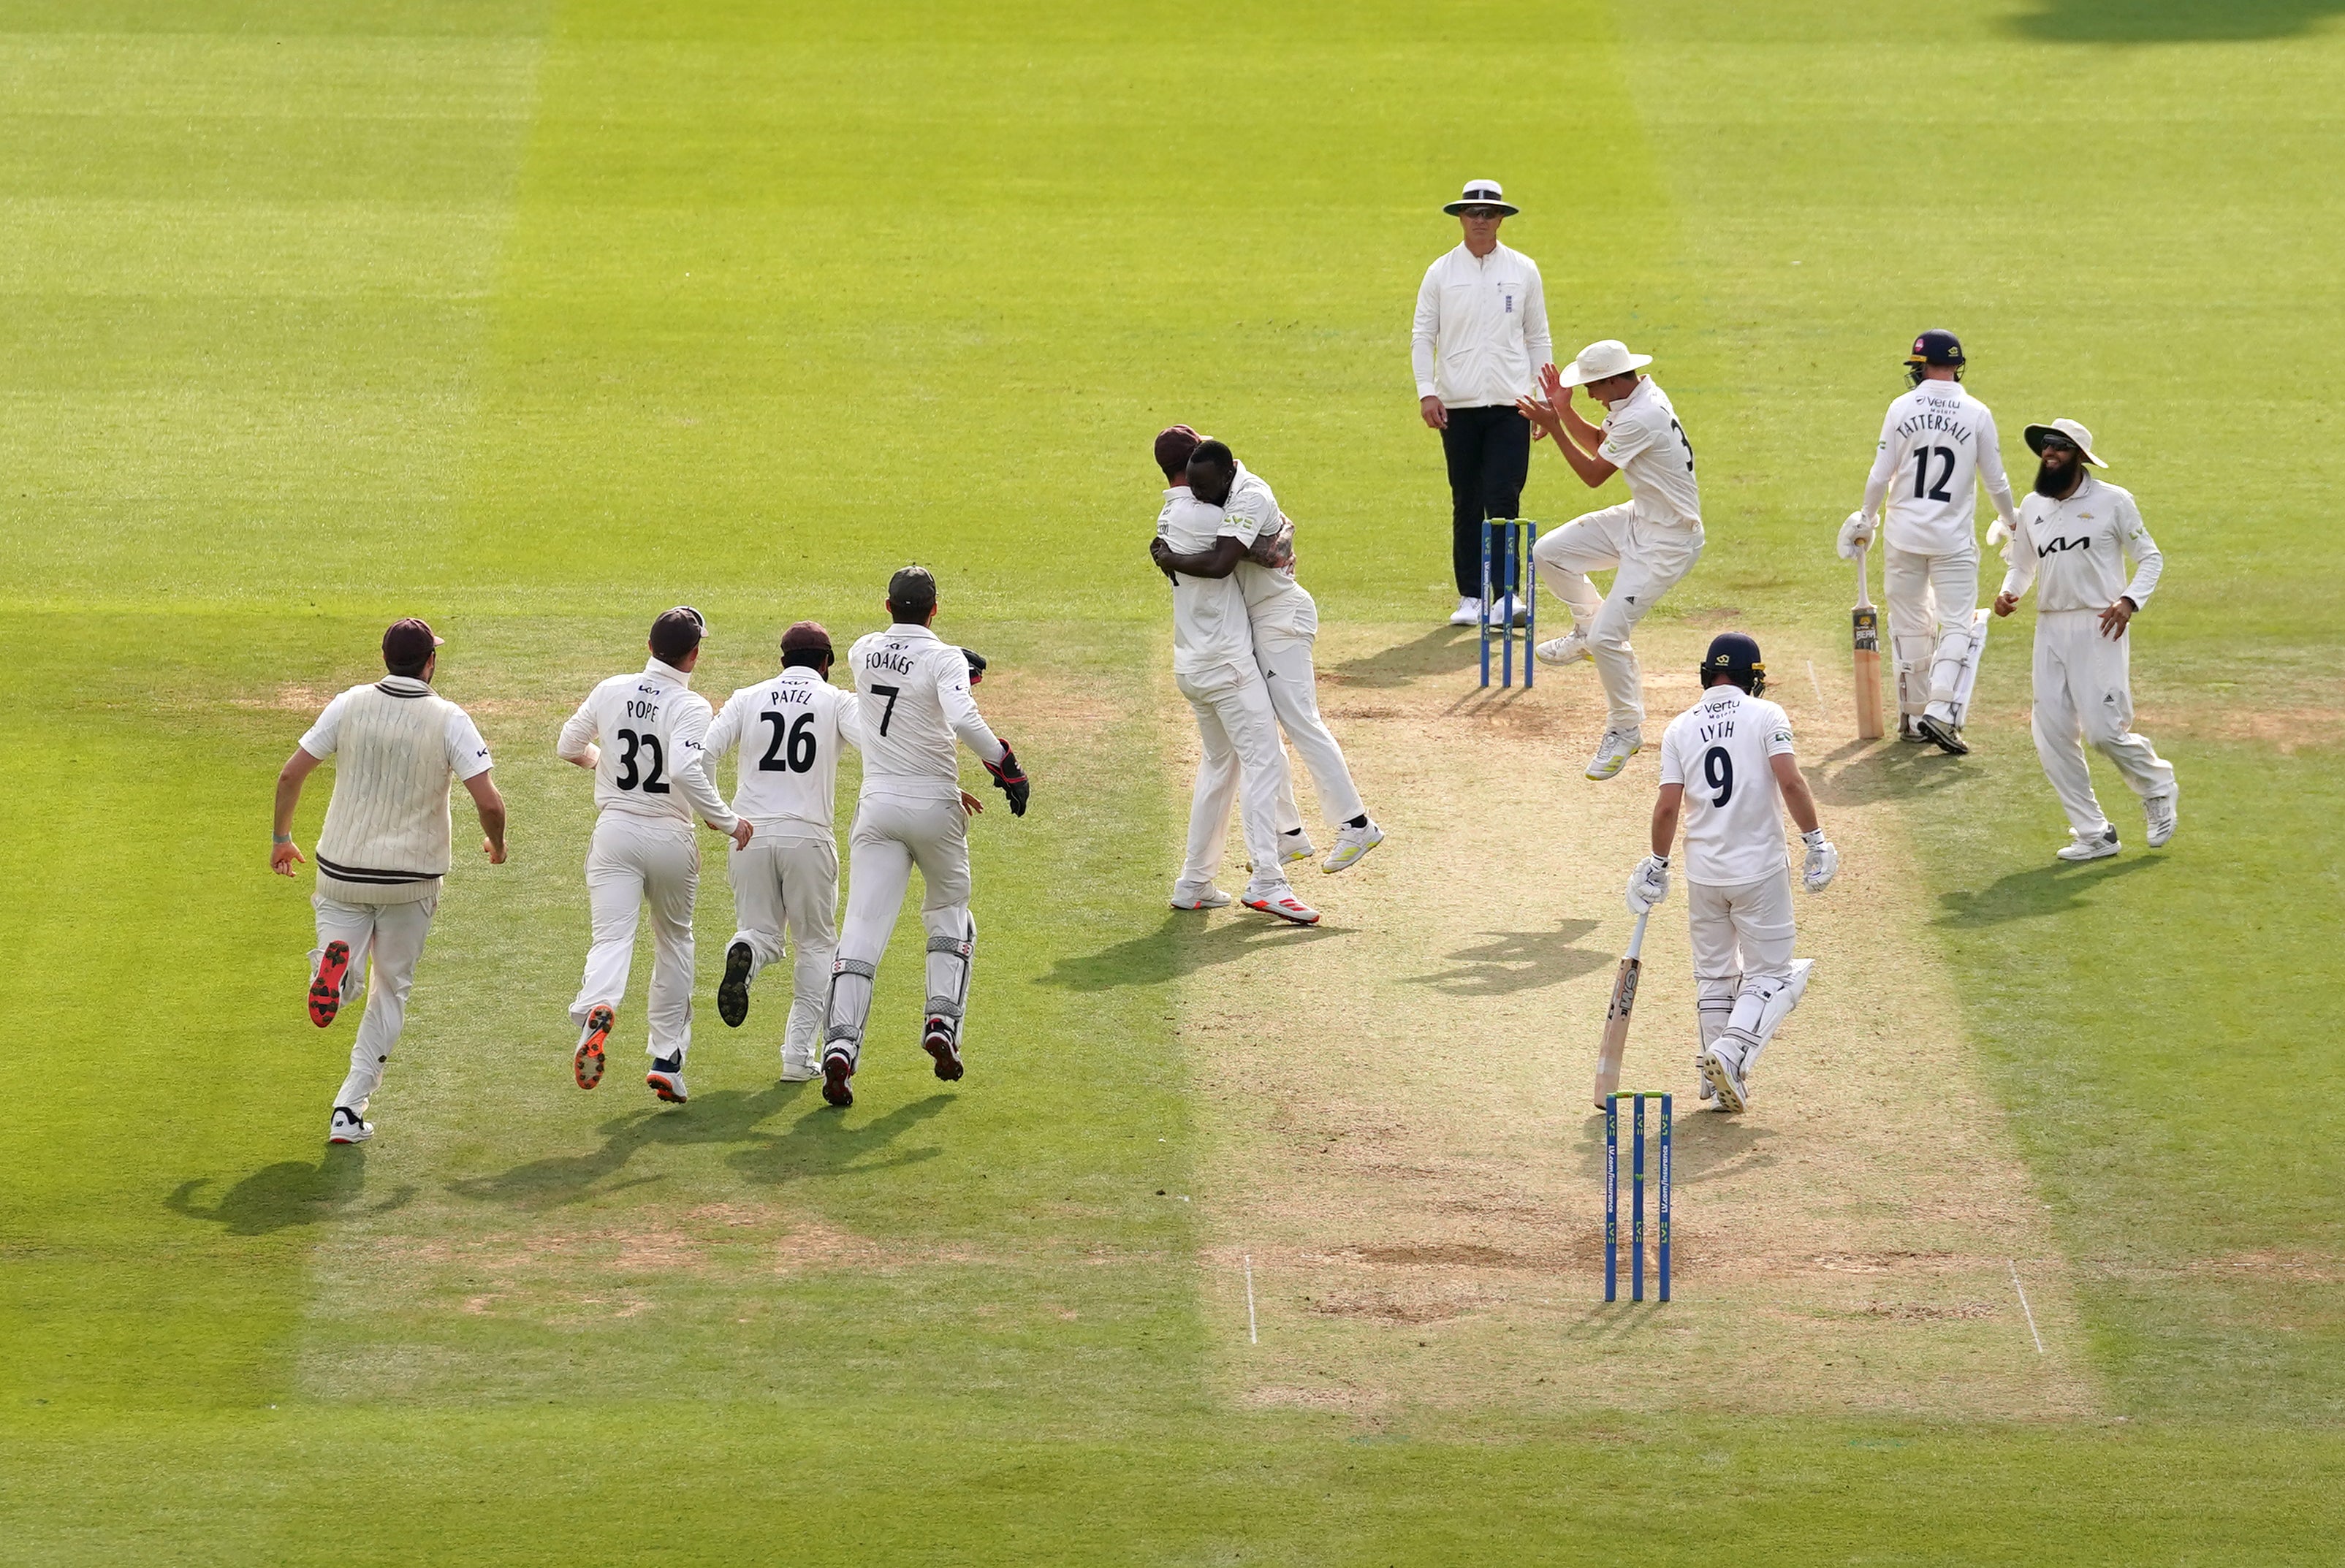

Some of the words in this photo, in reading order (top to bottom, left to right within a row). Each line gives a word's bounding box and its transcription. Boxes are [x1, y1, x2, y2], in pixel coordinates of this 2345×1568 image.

[1896, 414, 1972, 446] TATTERSALL
[1912, 444, 1956, 503] 12
[866, 652, 914, 675] FOAKES
[627, 700, 660, 723] POPE
[771, 689, 813, 706] PATEL
[870, 684, 900, 737] 7
[759, 711, 817, 774] 26
[1700, 721, 1735, 743] LYTH
[617, 728, 670, 794] 32
[1704, 746, 1733, 808] 9
